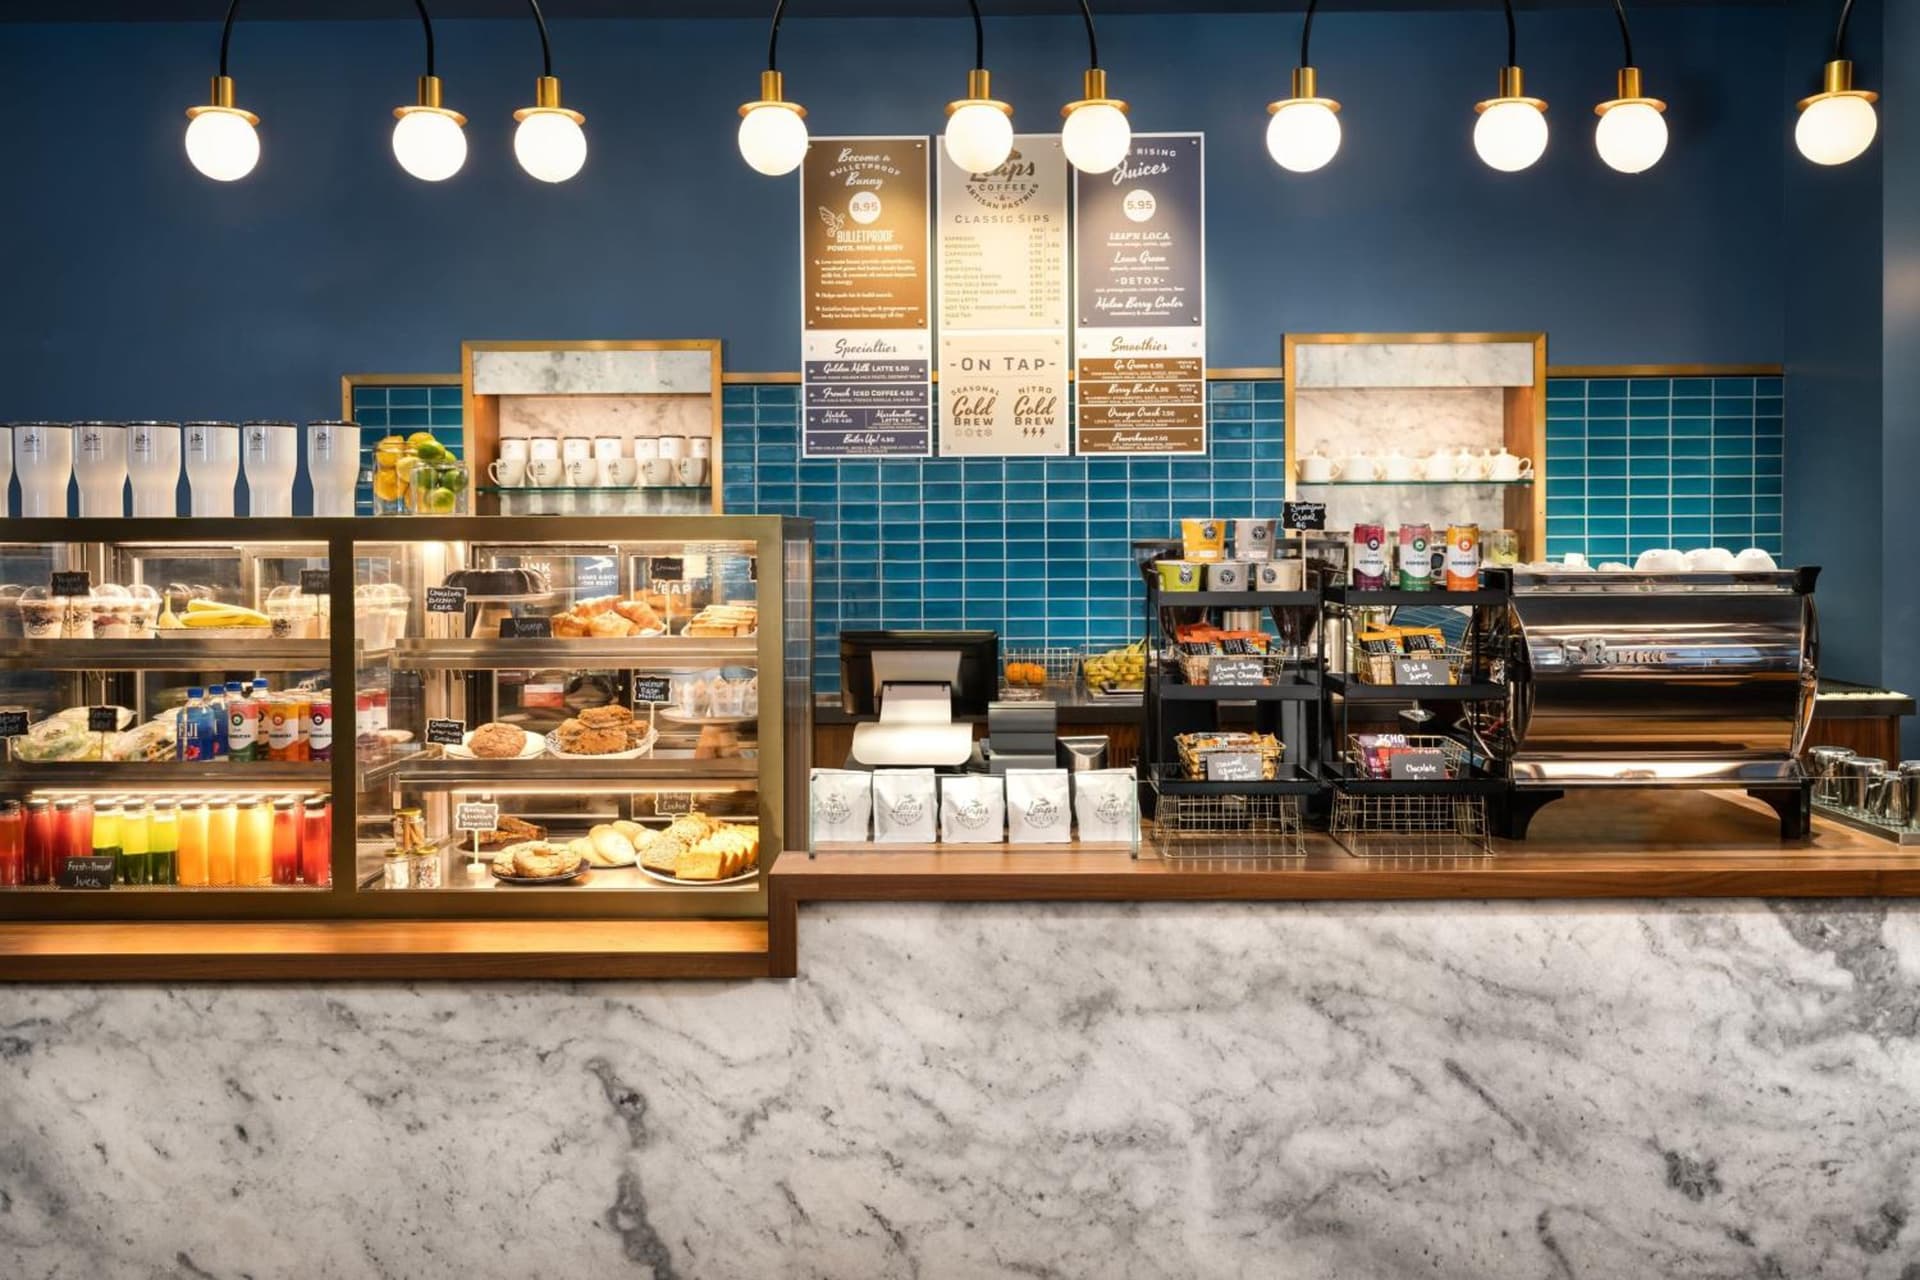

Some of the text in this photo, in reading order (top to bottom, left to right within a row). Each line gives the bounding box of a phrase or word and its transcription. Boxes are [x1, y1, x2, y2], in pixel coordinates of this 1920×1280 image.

[838, 148, 880, 162] Become
[1136, 148, 1176, 157] RISING
[829, 163, 901, 177] BULLETPROOF
[1112, 159, 1170, 185] Juices
[846, 172, 883, 190] Bunny
[978, 184, 1026, 192] COFFEE
[965, 183, 1040, 209] ARTISAN PASTRIES
[1127, 200, 1153, 211] 5.95
[954, 214, 1050, 224] CLASSIC SIPS
[1125, 296, 1152, 311] Berry
[1155, 295, 1184, 309] Cooler
[835, 338, 897, 358] Specialties
[1111, 336, 1168, 353] Smoothies
[823, 362, 849, 374] Golden
[1126, 360, 1148, 371] Green
[823, 388, 850, 399] French
[951, 385, 1000, 396] SEASONAL
[1018, 385, 1053, 395] NITRO
[1108, 384, 1131, 396] Berry
[952, 395, 997, 417] Cold
[1013, 395, 1057, 417] Cold
[1108, 407, 1135, 420] Orange
[954, 417, 994, 426] BREW
[1014, 417, 1055, 426] BREW
[1112, 432, 1154, 442] Powerhouse
